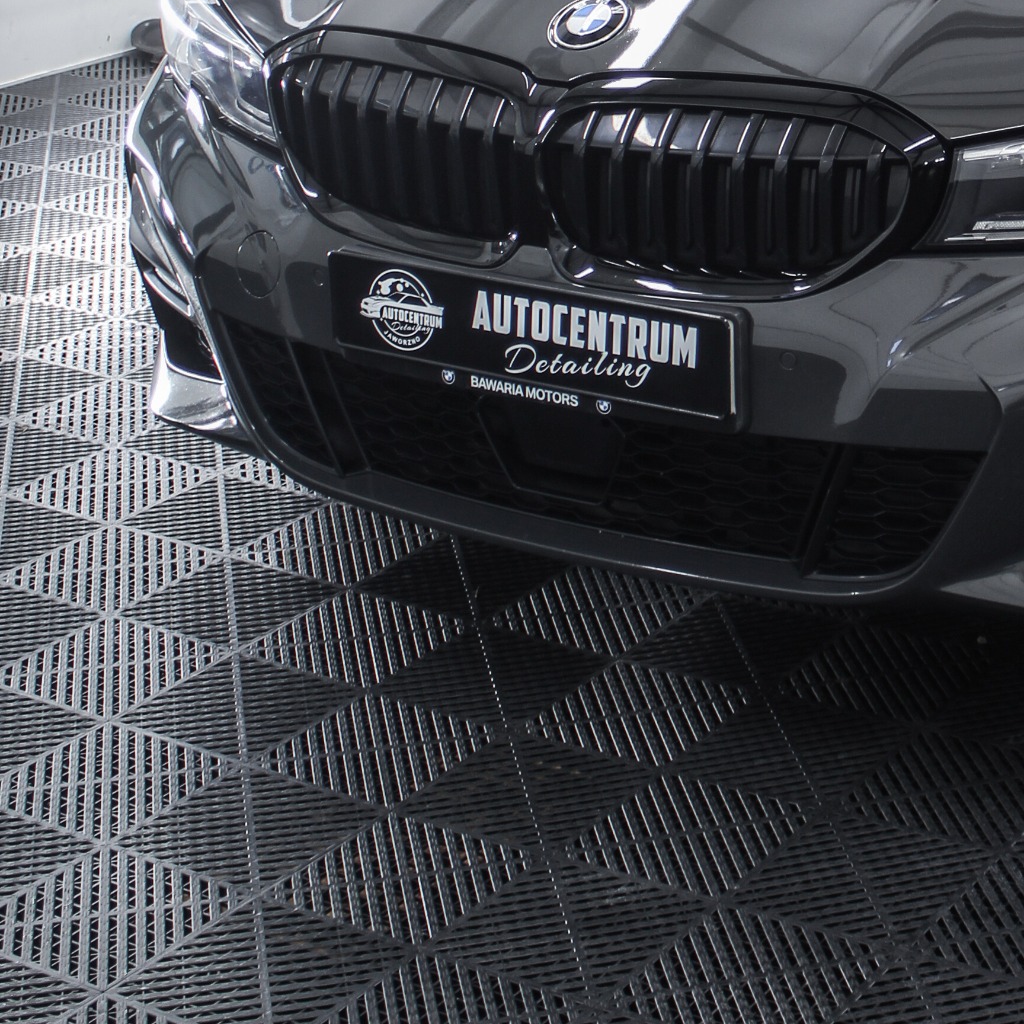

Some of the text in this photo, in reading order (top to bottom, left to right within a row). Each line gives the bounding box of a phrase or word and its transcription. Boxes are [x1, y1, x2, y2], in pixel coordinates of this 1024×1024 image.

[382, 306, 443, 330] AUTOCENTRUM
[391, 321, 432, 335] Detailing
[471, 290, 699, 370] AUTOCENTRUM
[383, 329, 421, 347] JAWORZNO
[504, 343, 652, 389] Detailing
[470, 375, 579, 408] BAWARIA MOTORS
